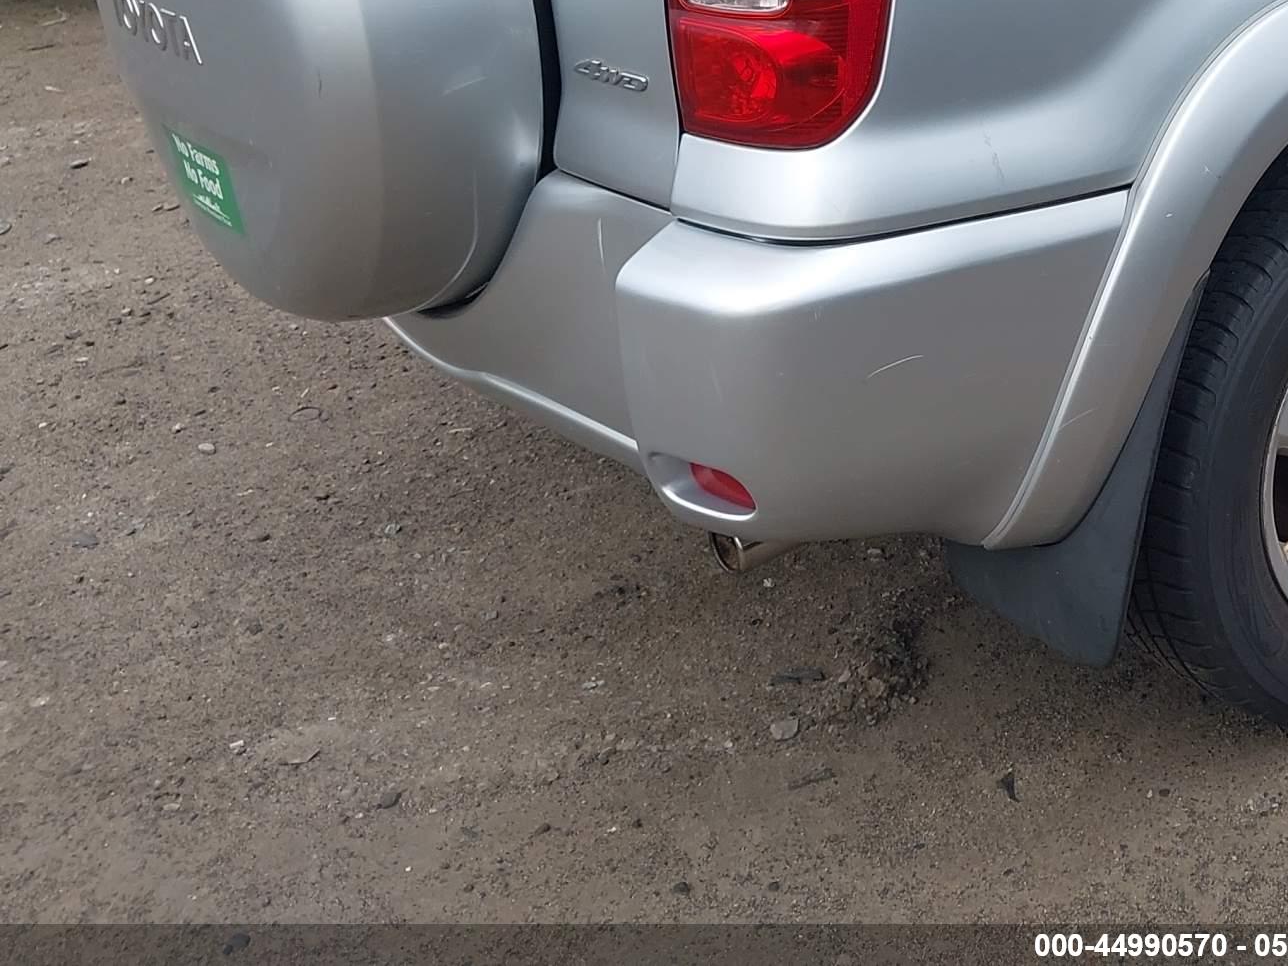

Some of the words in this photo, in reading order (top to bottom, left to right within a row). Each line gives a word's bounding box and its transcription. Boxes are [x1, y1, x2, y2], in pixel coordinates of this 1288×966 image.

[575, 59, 649, 92] 4WD
[172, 133, 189, 158] No
[186, 141, 220, 175] Farms
[183, 160, 199, 184] No
[197, 168, 224, 200] Food
